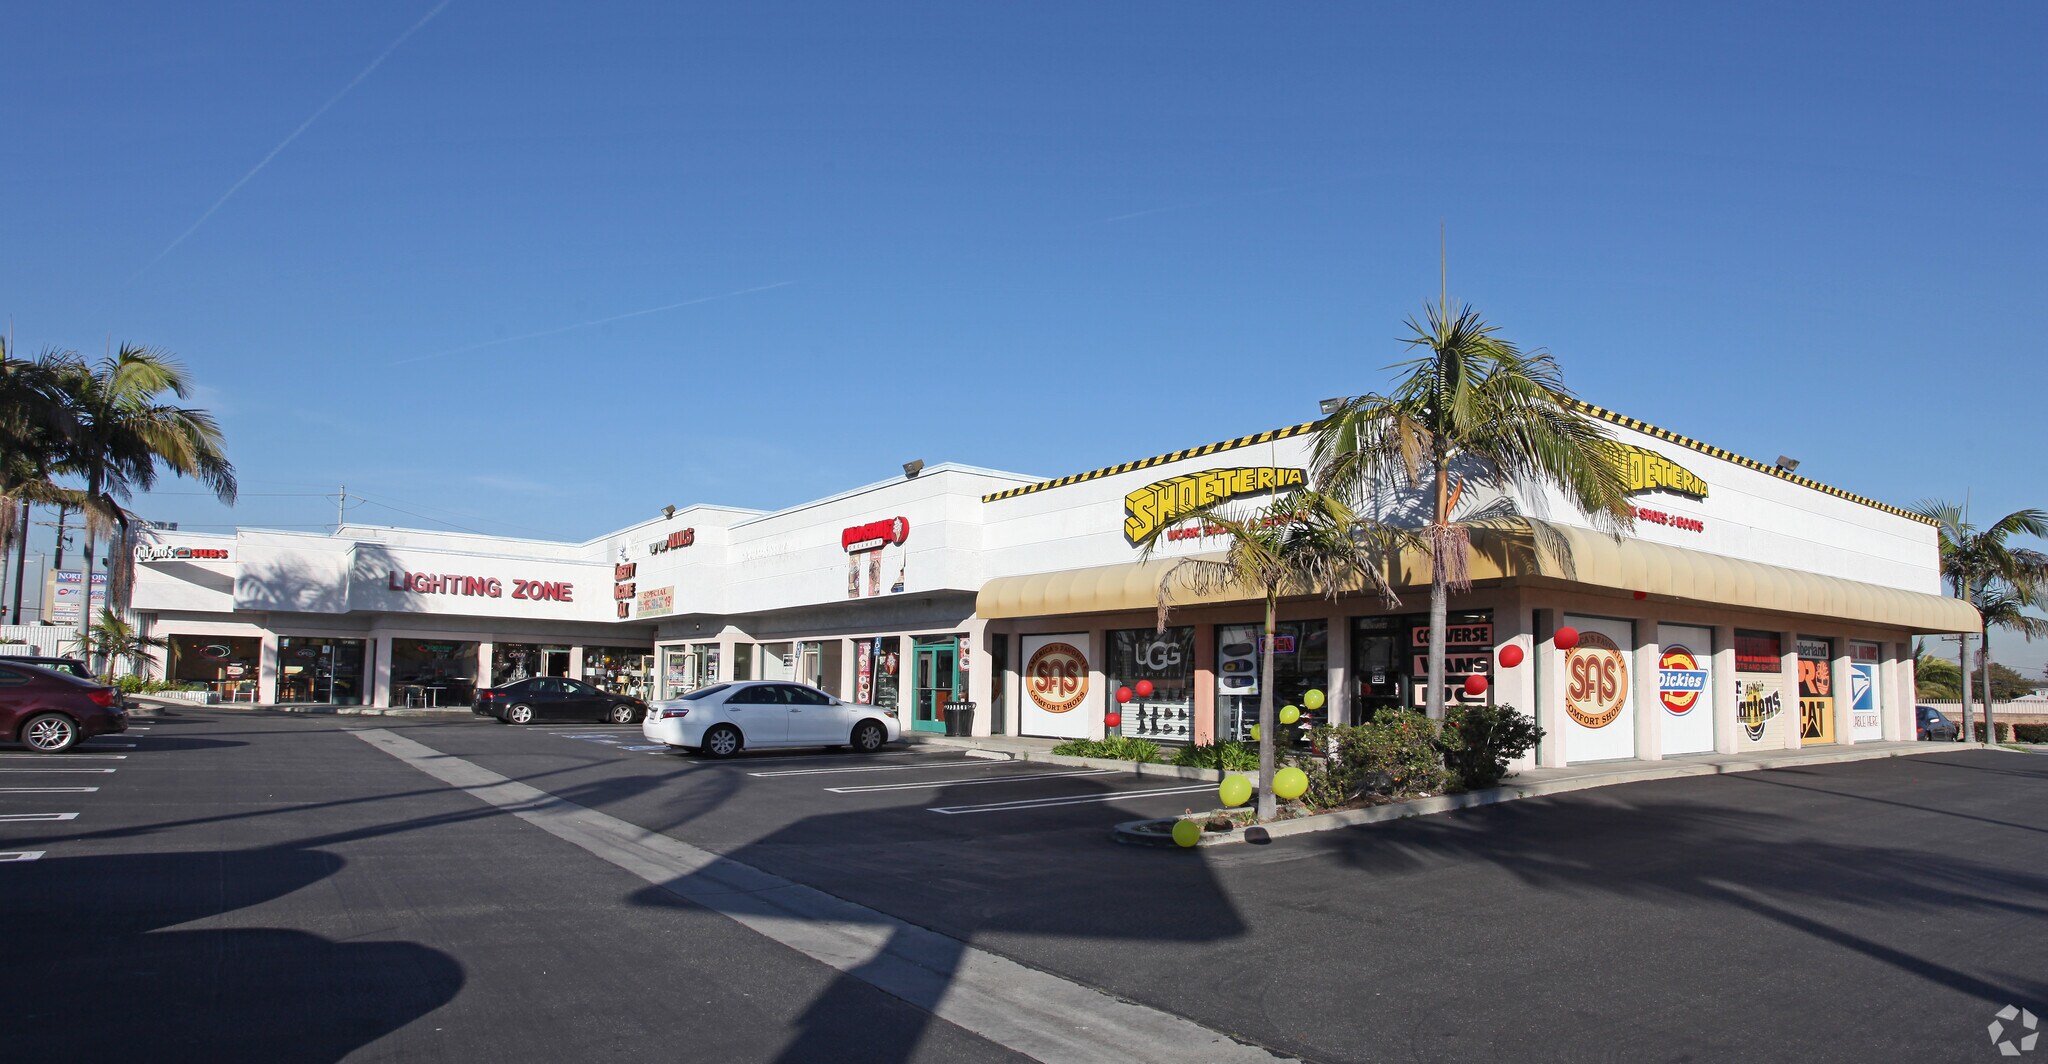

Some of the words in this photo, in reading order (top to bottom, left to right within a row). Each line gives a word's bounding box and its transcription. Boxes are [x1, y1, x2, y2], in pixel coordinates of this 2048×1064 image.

[1125, 467, 1304, 544] SHOETERIA
[389, 571, 502, 598] LIGHTING
[512, 579, 574, 602] ZONE
[1416, 627, 1488, 643] COVERSE
[1135, 641, 1181, 671] UGG
[1035, 659, 1078, 697] SAS
[1569, 655, 1616, 706] SAS
[1030, 690, 1061, 711] COMFORT
[1063, 691, 1085, 711] SHOES
[1602, 698, 1623, 724] SHOES
[1736, 690, 1780, 720] artens
[1800, 701, 1825, 738] CAT
